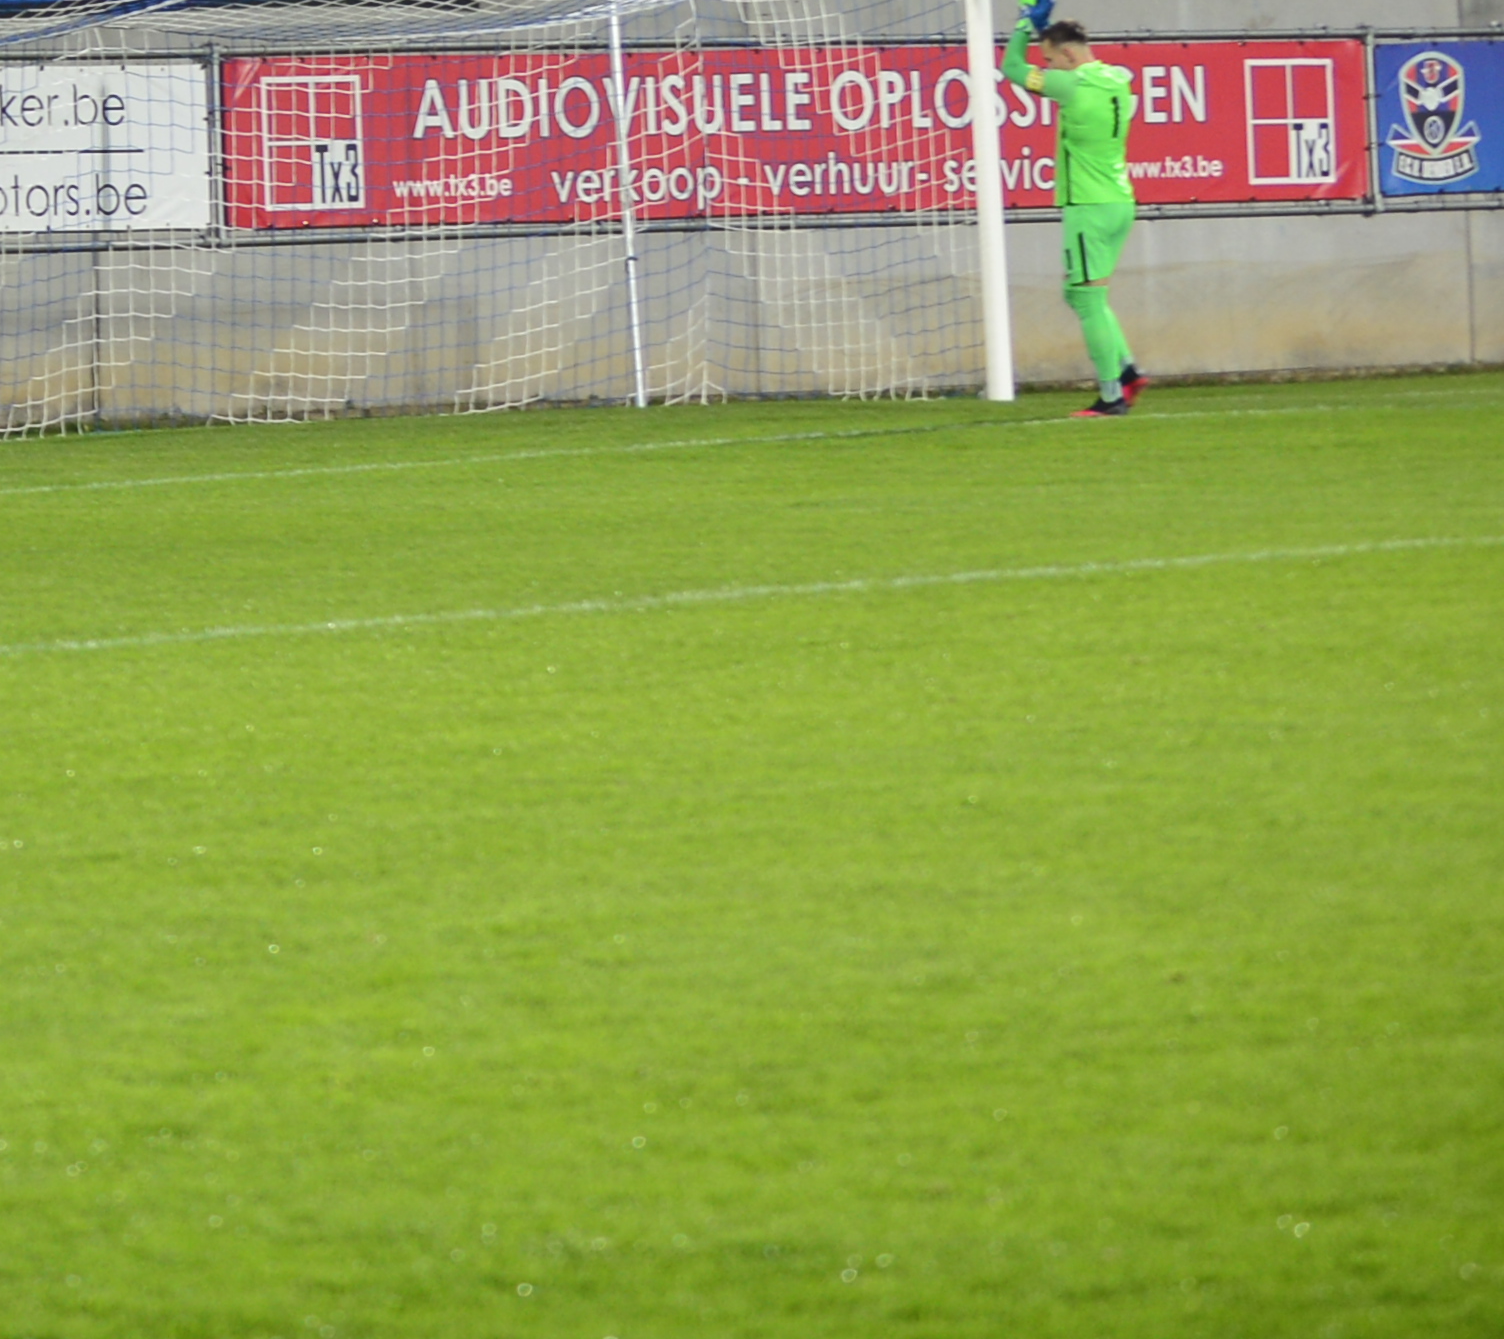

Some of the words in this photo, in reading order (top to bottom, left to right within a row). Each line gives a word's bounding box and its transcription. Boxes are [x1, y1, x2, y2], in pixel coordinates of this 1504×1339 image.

[412, 71, 812, 140] AUDIOVISUELE
[1111, 96, 1122, 139] 1
[315, 143, 360, 203] Tx3
[1292, 122, 1331, 177] Tx3
[392, 173, 513, 199] www.tx3.be
[551, 161, 723, 211] verkoop
